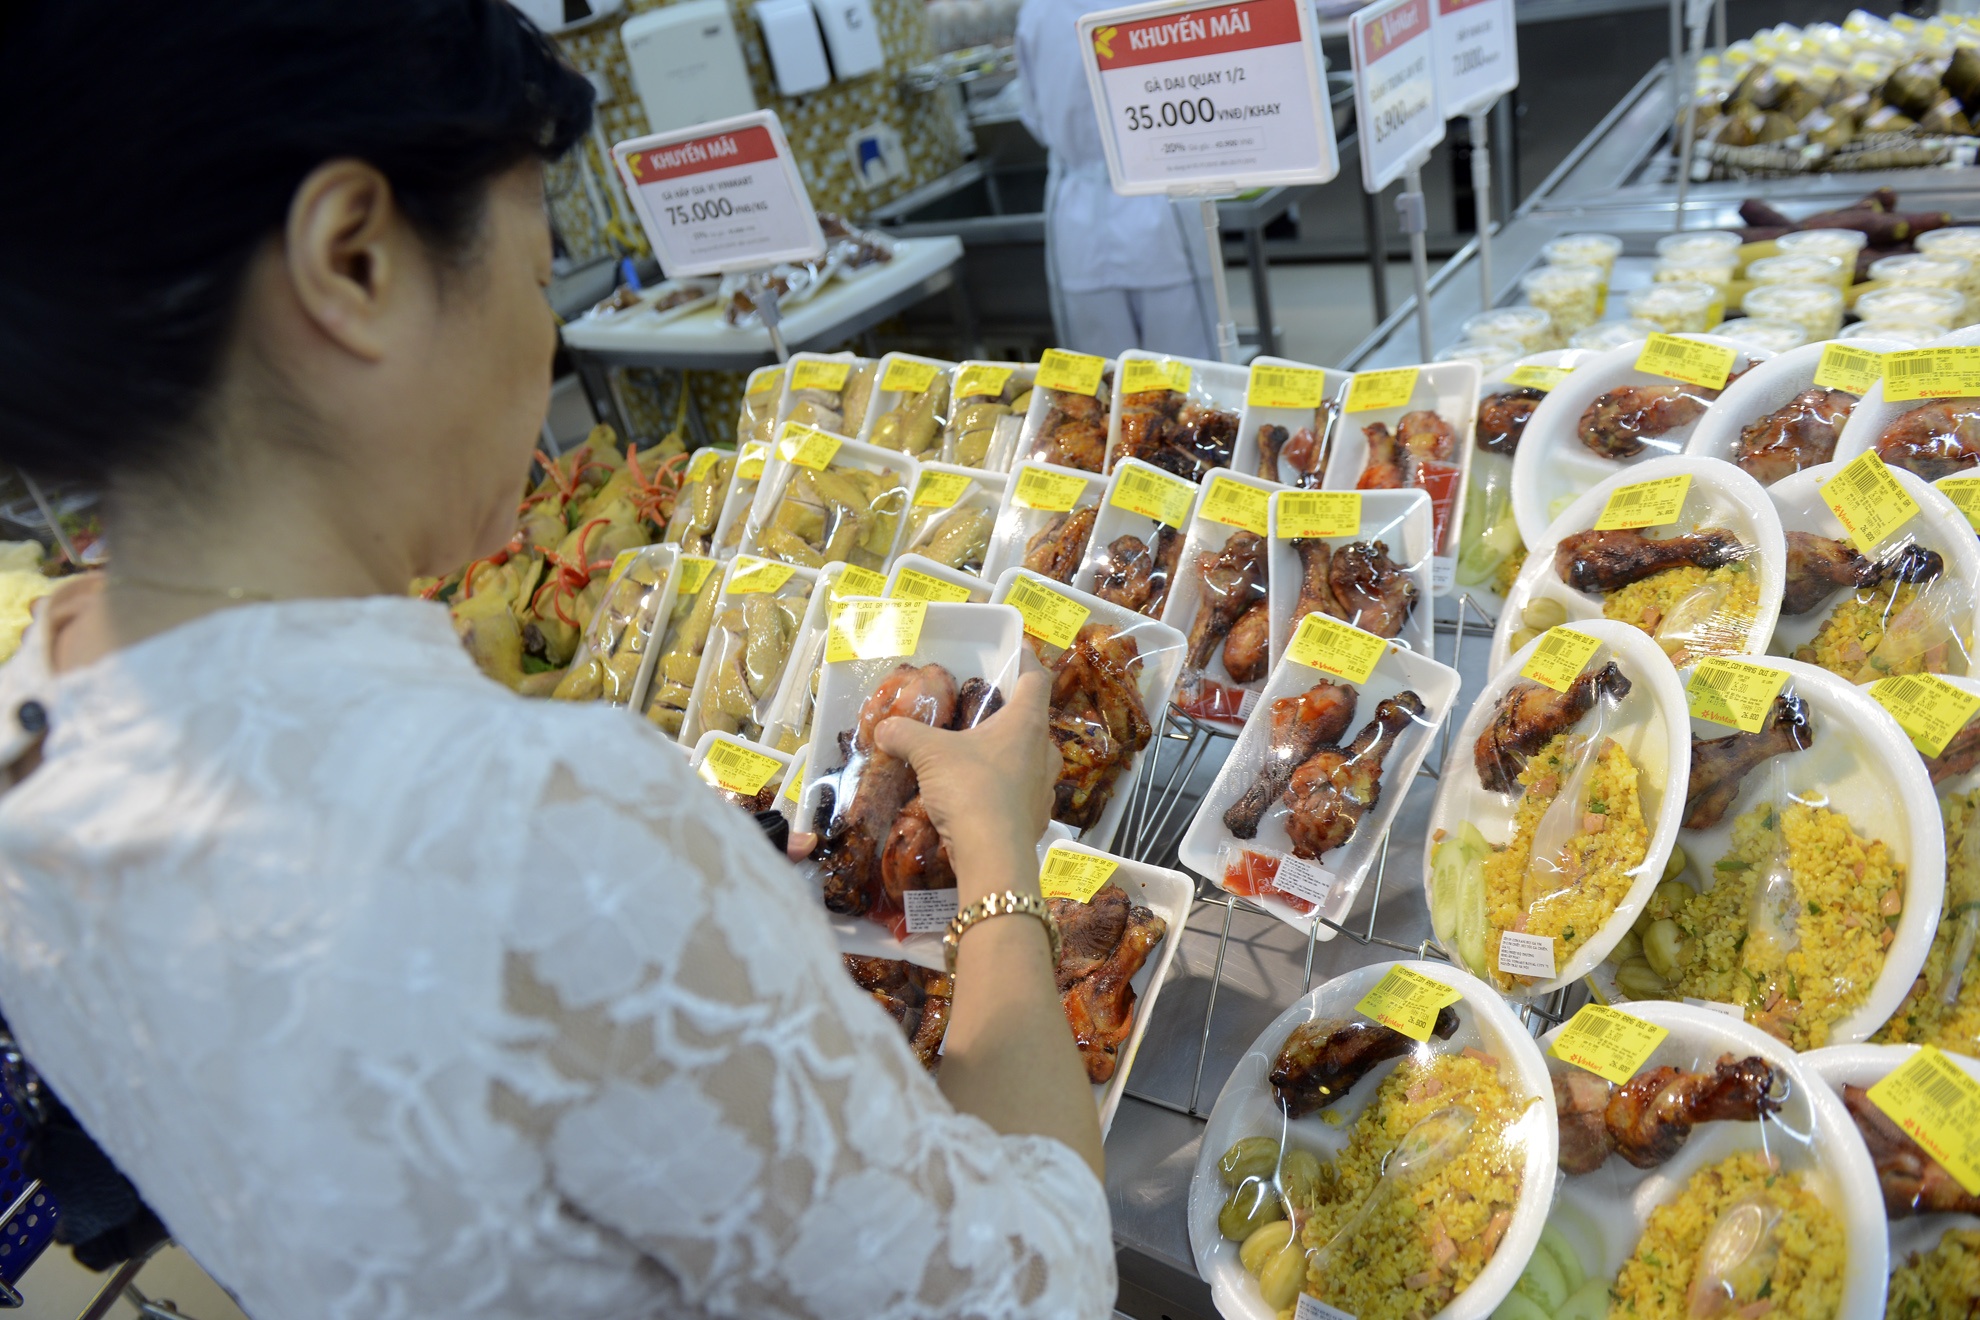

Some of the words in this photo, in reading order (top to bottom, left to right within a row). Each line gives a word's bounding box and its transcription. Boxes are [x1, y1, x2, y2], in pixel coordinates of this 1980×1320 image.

[1128, 14, 1206, 51] KHUYẾN
[1211, 7, 1250, 37] MÃI
[1145, 79, 1162, 92] GÀ
[1165, 77, 1186, 90] DAI
[1188, 71, 1221, 88] QUAY
[1226, 68, 1246, 84] 1/2
[1125, 97, 1215, 131] 35.000
[650, 142, 707, 171] KHUYẾN
[708, 135, 737, 157] MÃI
[665, 196, 733, 226] 75.000
[1710, 711, 1737, 725] VinMart
[1741, 711, 1760, 721] 26.800
[1576, 1055, 1602, 1071] VinMart
[1609, 1060, 1631, 1073] 26.800
